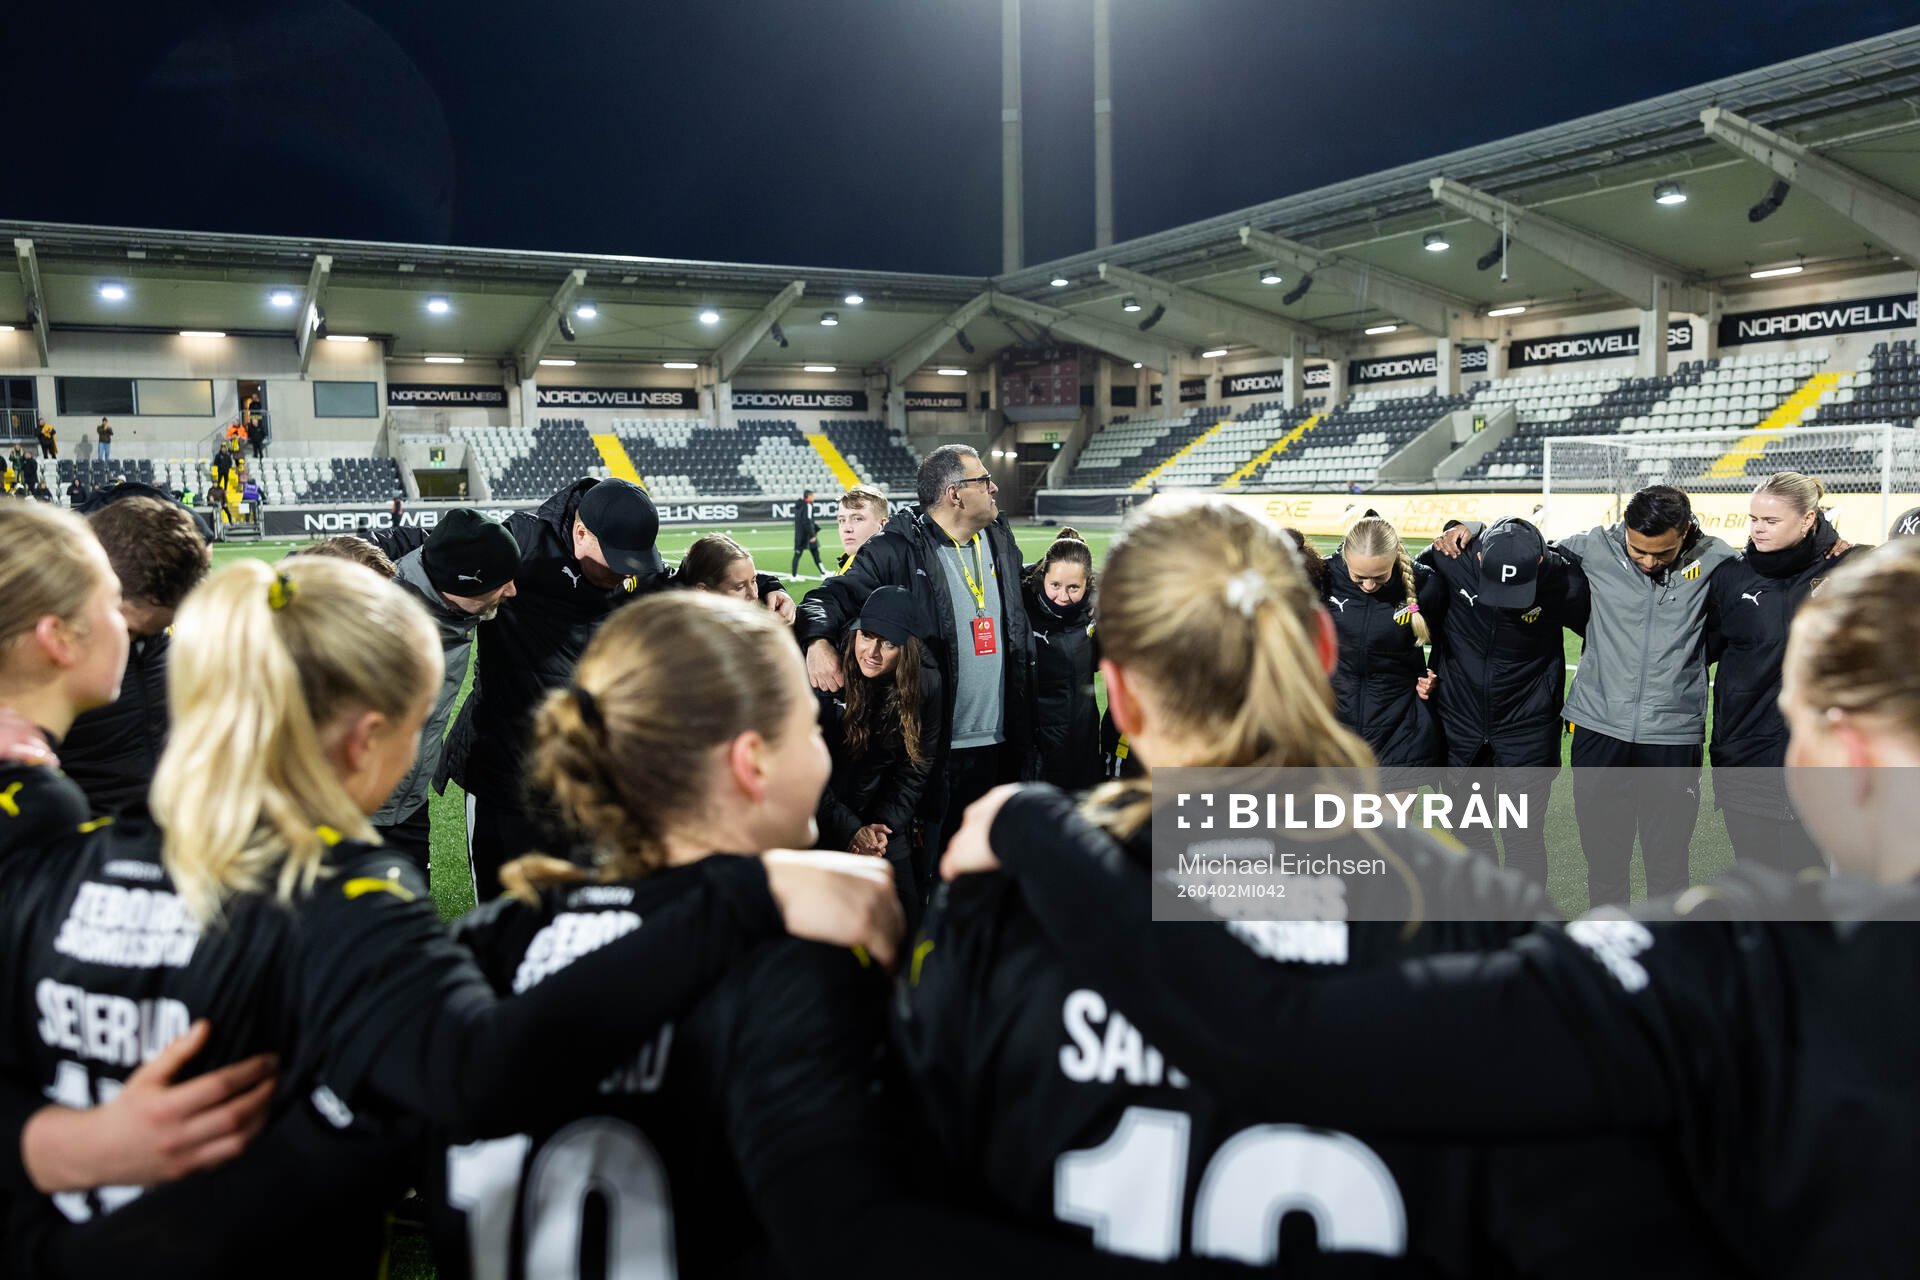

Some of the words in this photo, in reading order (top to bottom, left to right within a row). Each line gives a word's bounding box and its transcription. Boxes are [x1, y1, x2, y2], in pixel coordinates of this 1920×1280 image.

[391, 390, 501, 401] NORDICWELLNESS
[536, 391, 683, 404] NORDICWELLNESS
[656, 505, 739, 520] ELLNESS
[1501, 564, 1517, 582] P
